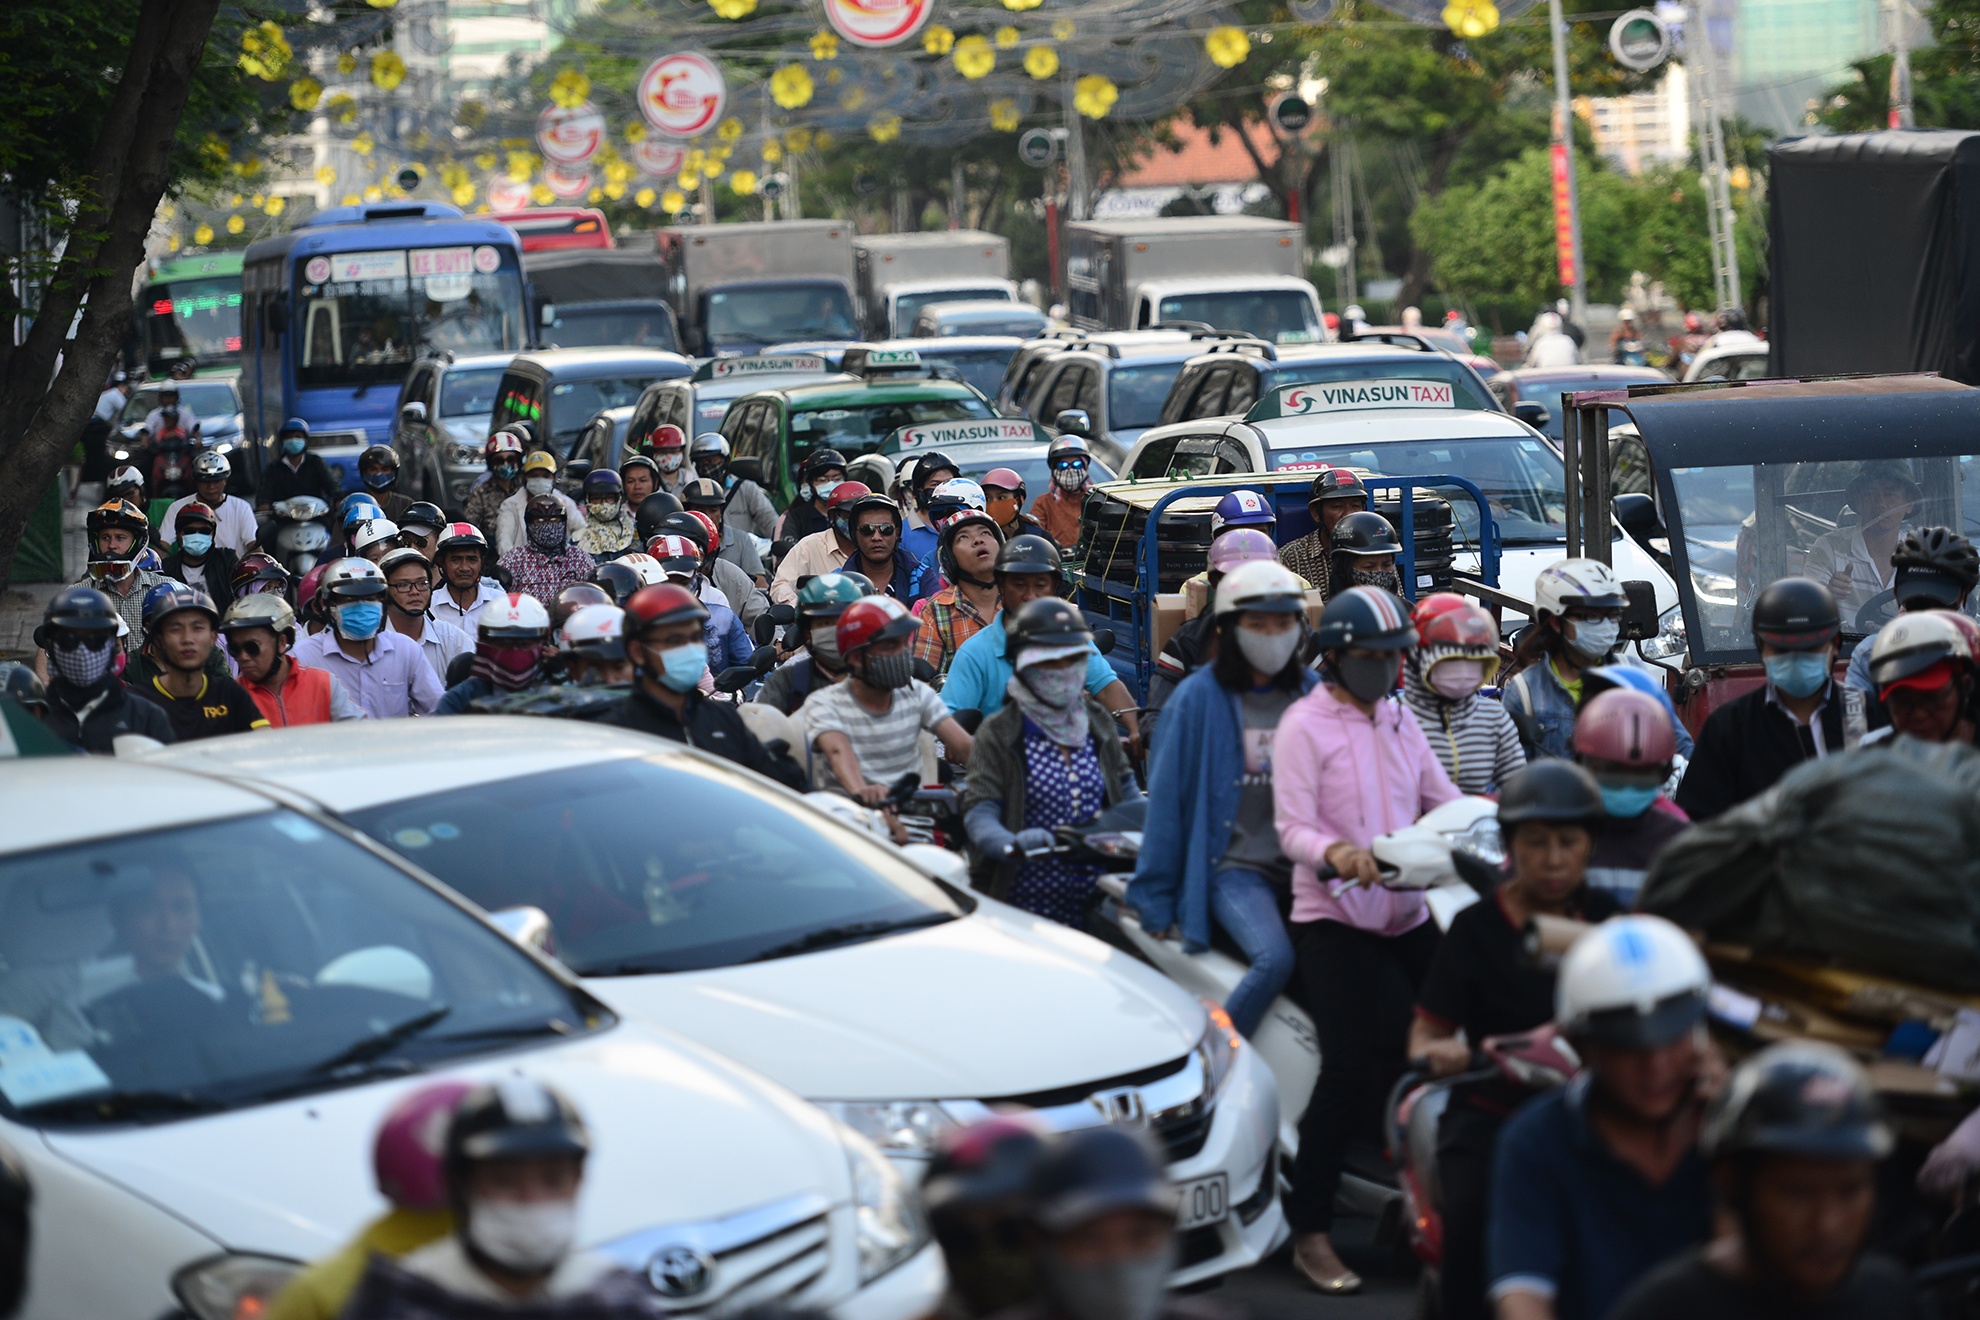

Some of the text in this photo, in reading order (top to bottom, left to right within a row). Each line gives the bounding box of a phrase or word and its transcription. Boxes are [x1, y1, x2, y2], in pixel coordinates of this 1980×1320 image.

[871, 351, 916, 363] TAXI
[737, 359, 820, 371] VINASUN TAXI
[1323, 385, 1450, 404] VINASUN TAXI
[931, 424, 1033, 442] VINASUN TAXI
